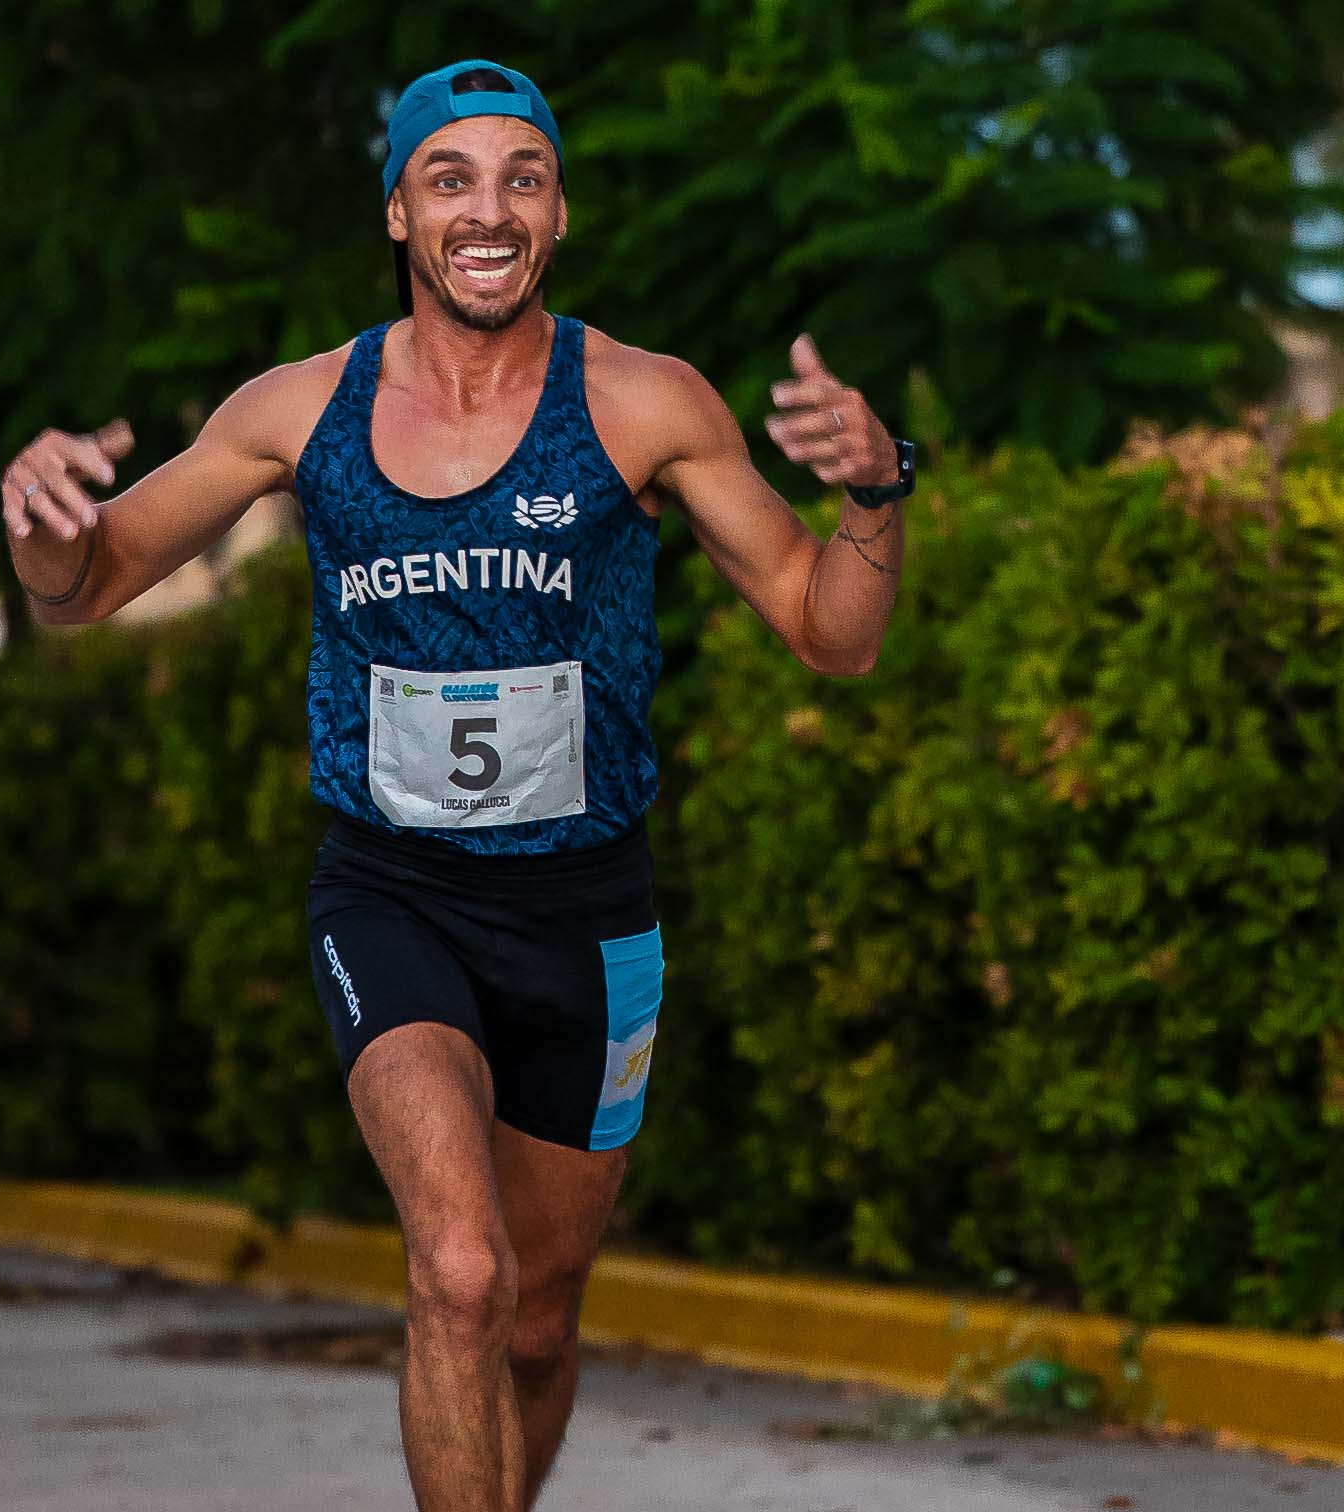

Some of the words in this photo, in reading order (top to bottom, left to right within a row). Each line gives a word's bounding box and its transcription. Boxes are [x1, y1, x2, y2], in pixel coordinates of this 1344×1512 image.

[340, 548, 572, 611] ARGENTINA
[447, 717, 503, 792] 5
[441, 798, 468, 810] LUCAS
[469, 795, 511, 810] GALLUCCI
